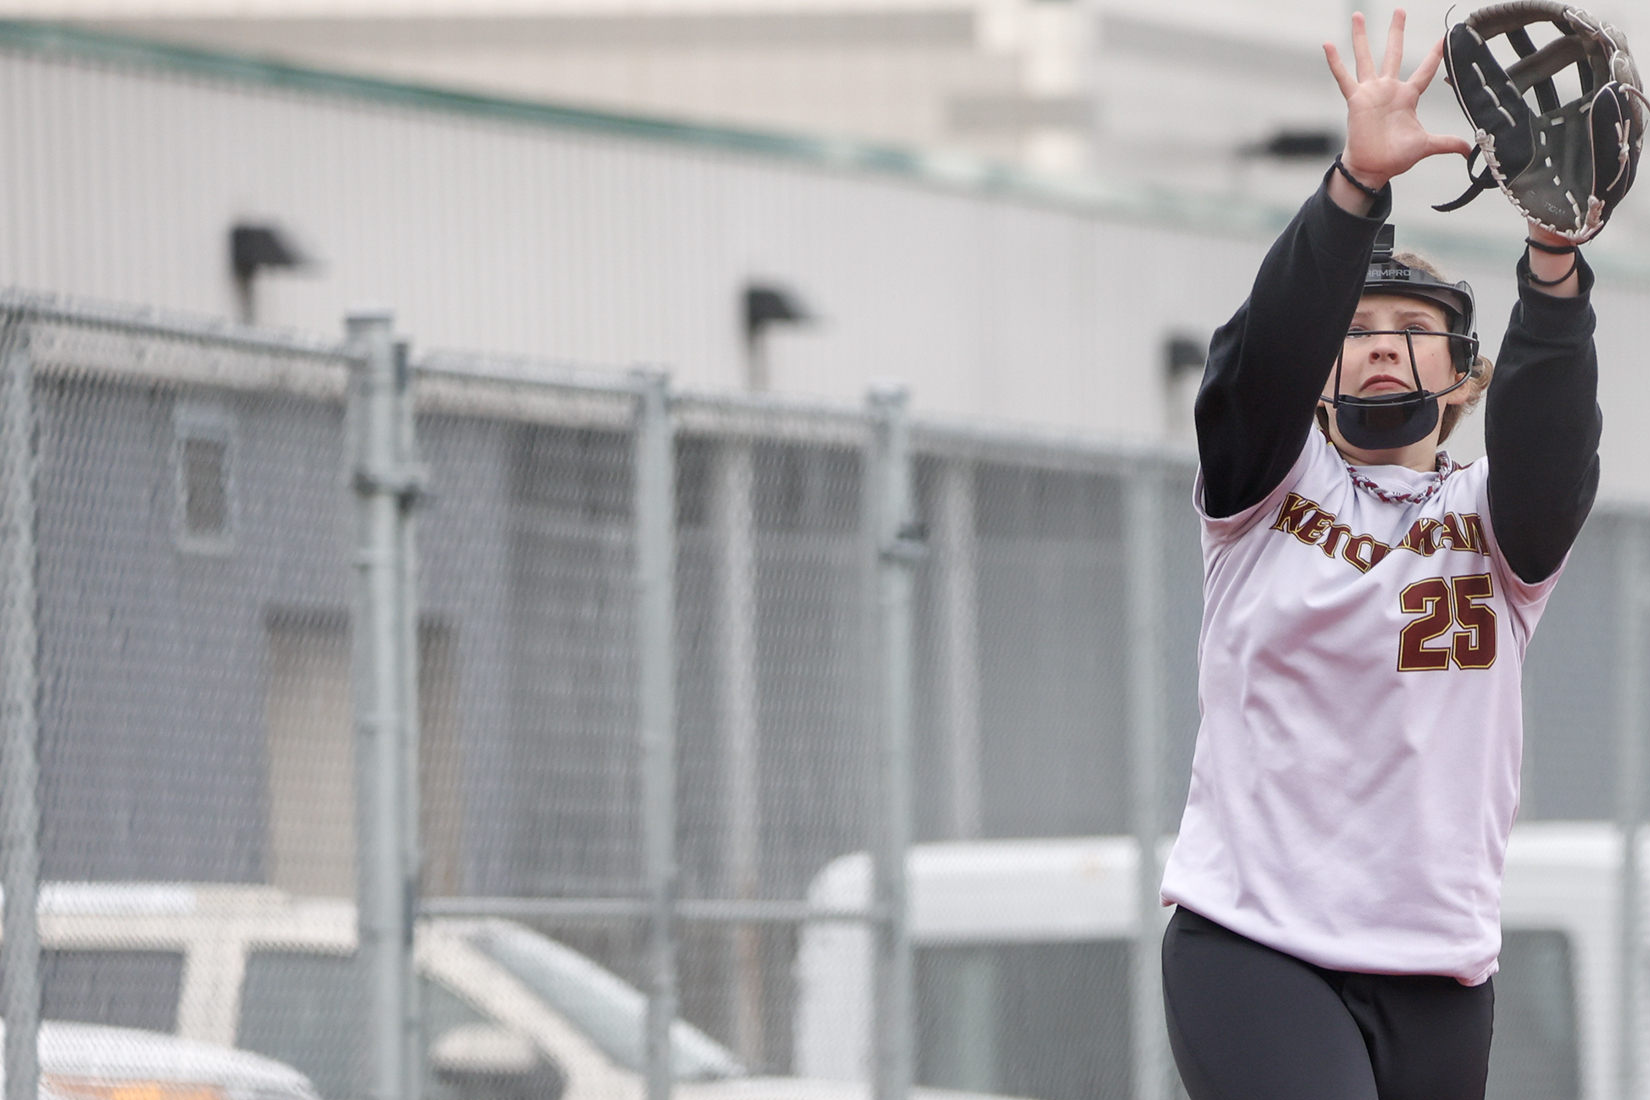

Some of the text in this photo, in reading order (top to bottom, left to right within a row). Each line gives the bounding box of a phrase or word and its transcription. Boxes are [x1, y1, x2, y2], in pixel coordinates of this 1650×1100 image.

[1366, 269, 1412, 278] HAMPRO
[1269, 492, 1491, 574] KETCKAN
[1397, 573, 1497, 672] 25
